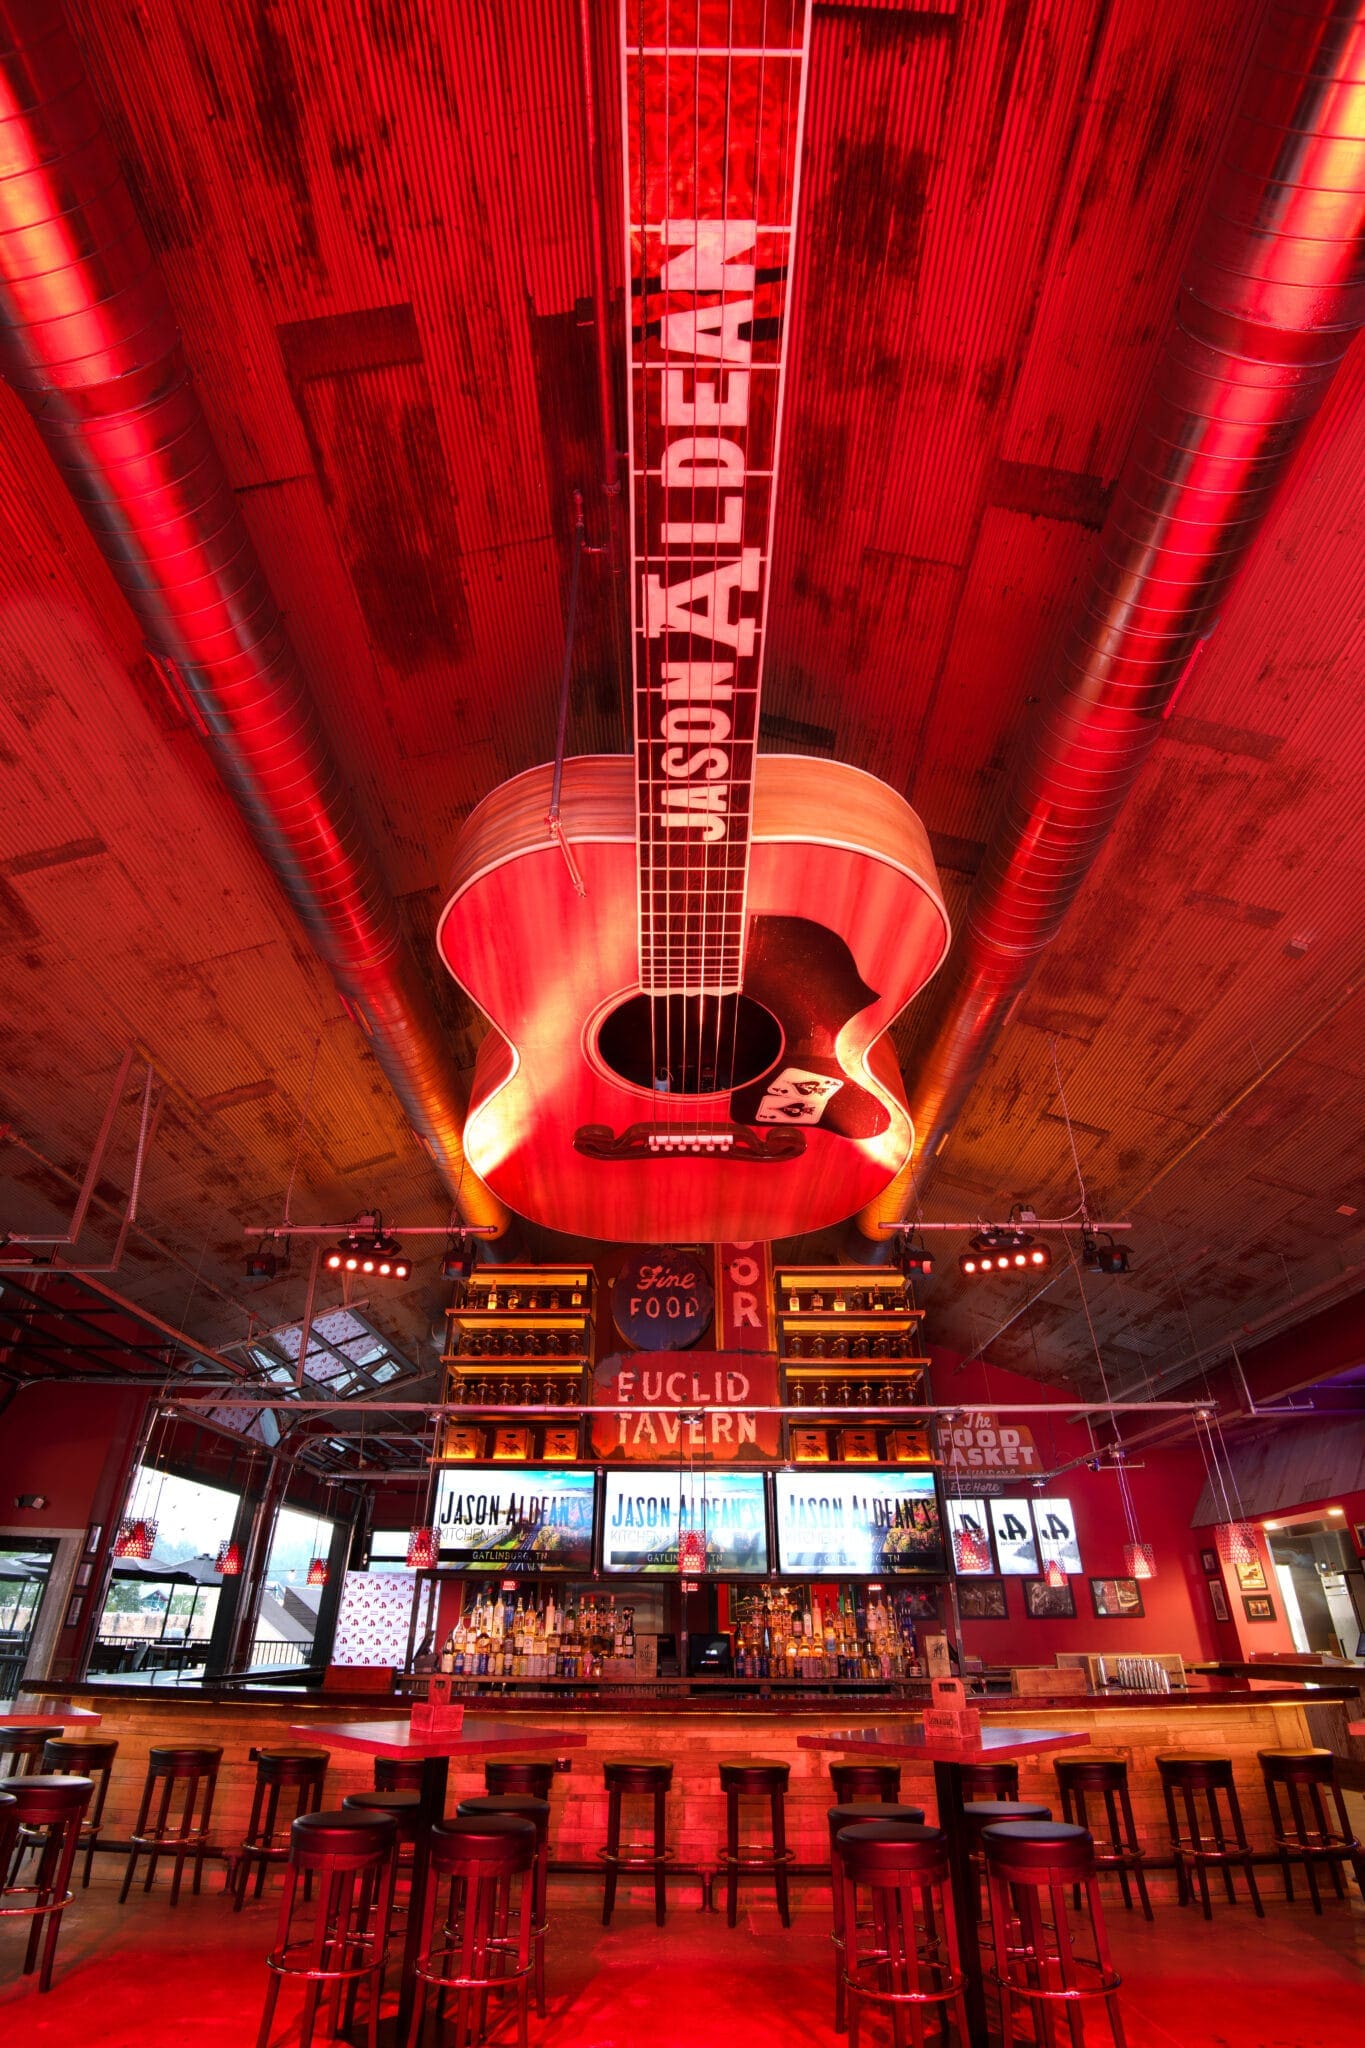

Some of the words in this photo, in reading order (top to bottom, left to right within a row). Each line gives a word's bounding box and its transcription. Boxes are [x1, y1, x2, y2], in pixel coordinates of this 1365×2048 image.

[642, 219, 760, 656] ALDEAN
[661, 661, 735, 840] JASON
[636, 1265, 696, 1290] Fine
[730, 1241, 762, 1327] OR
[630, 1297, 699, 1318] FOOD
[617, 1371, 751, 1402] EUCLID
[619, 1412, 757, 1444] TAVERN
[963, 1412, 992, 1429] The
[937, 1429, 1020, 1447] FOOD
[441, 1491, 500, 1525] JASON
[612, 1493, 670, 1528] JASON
